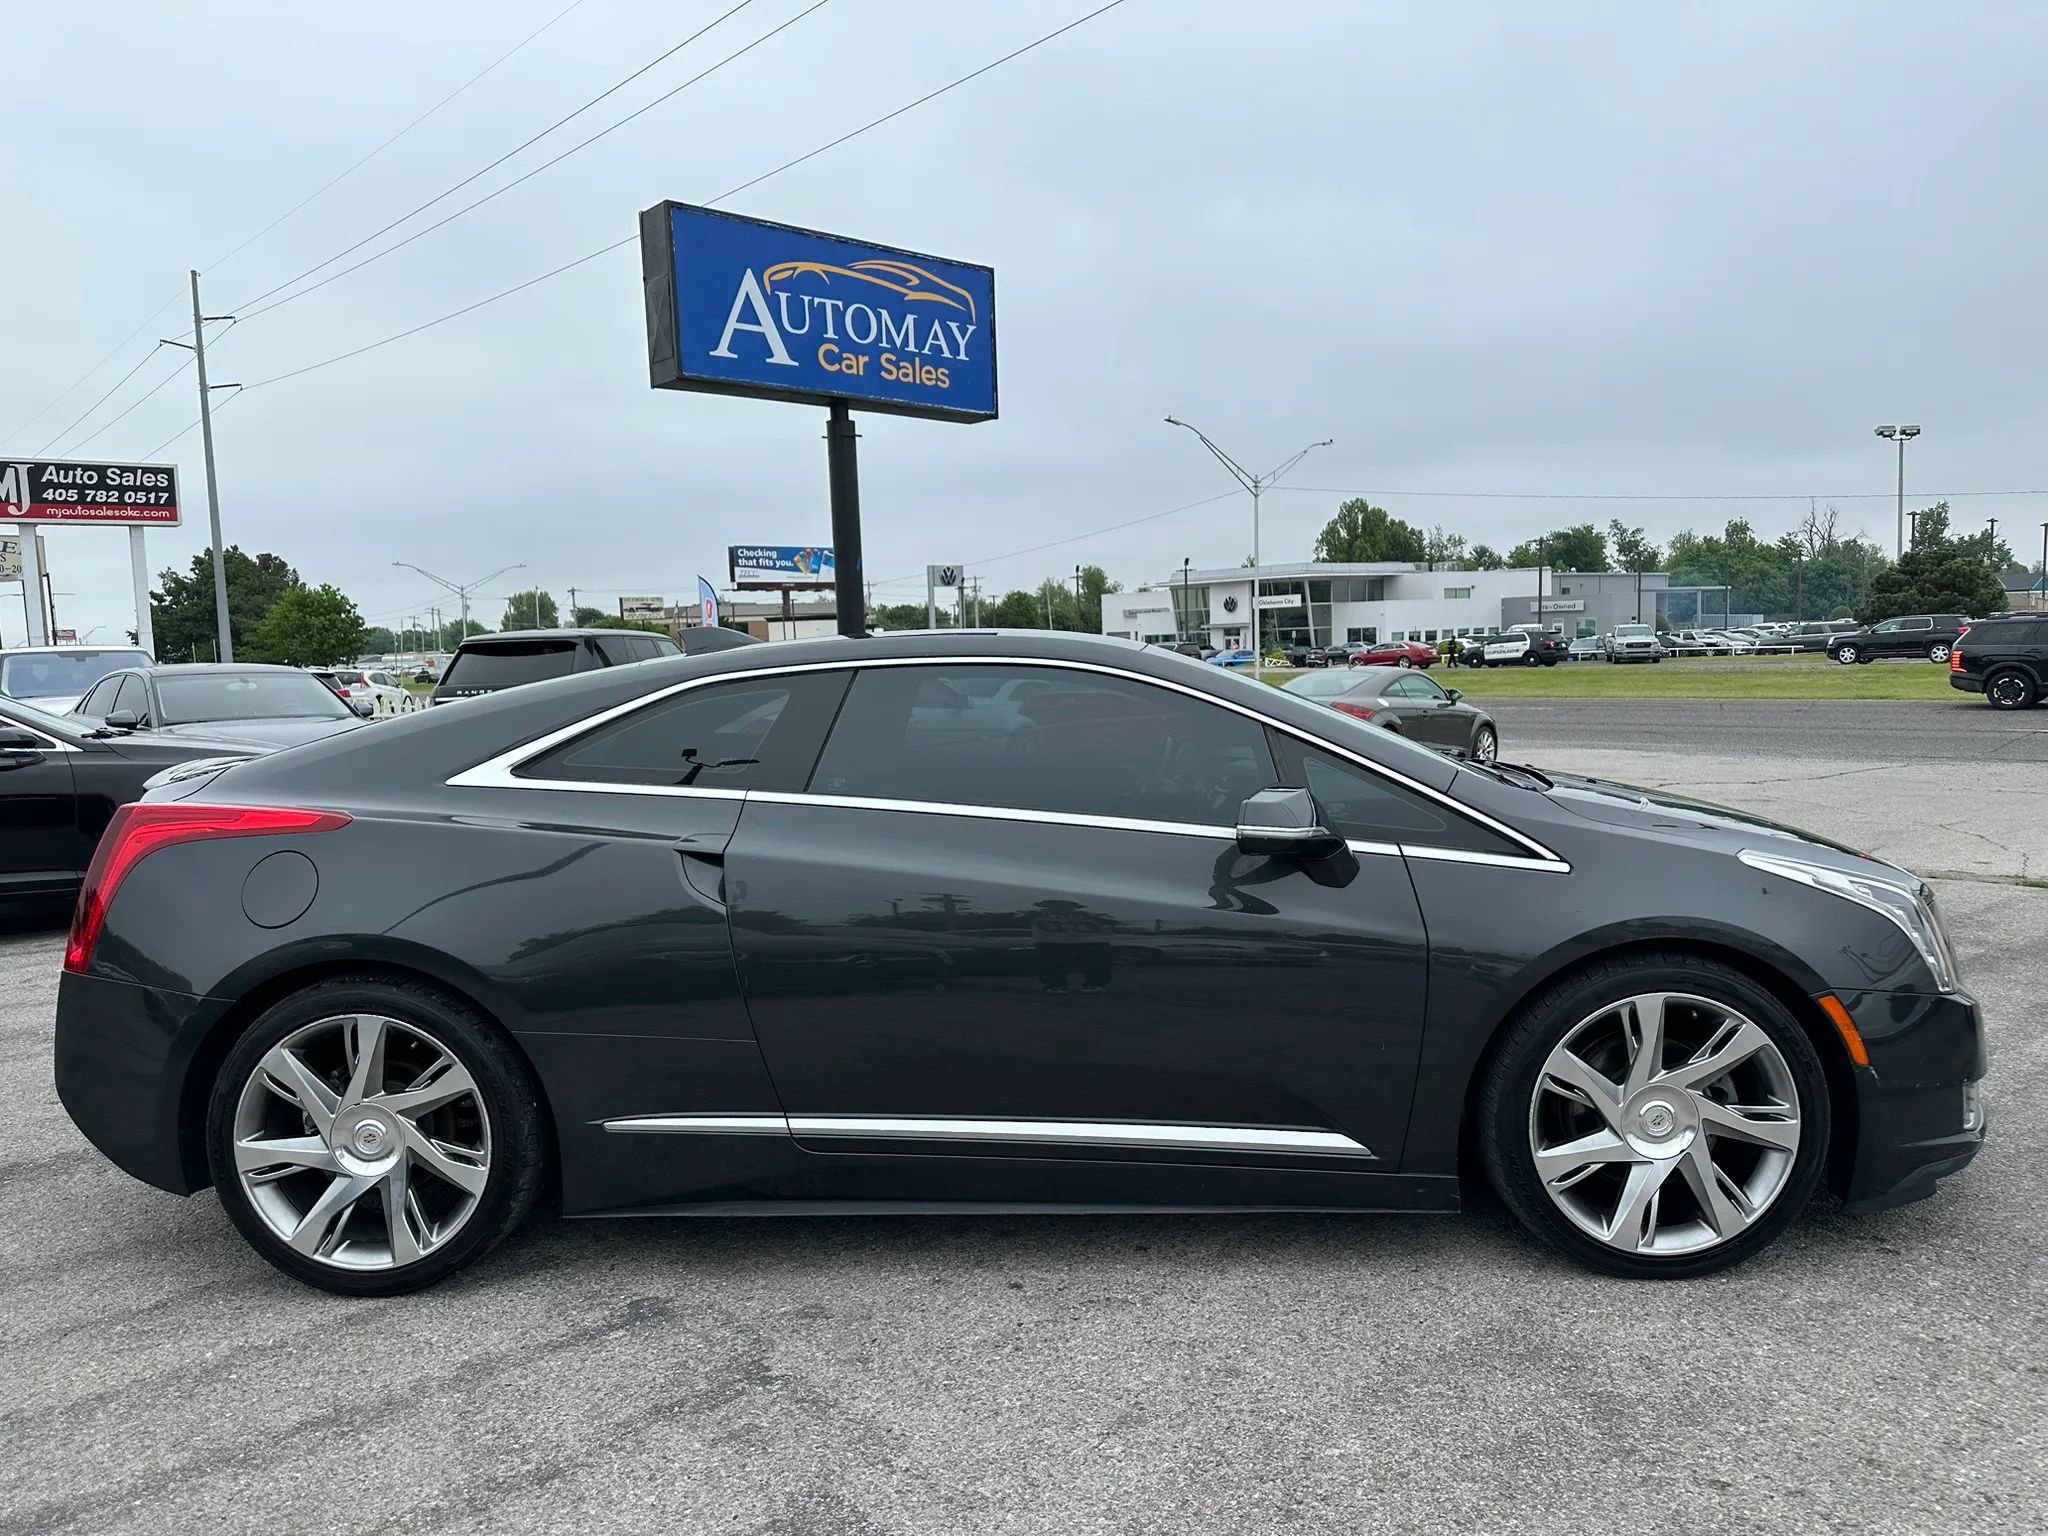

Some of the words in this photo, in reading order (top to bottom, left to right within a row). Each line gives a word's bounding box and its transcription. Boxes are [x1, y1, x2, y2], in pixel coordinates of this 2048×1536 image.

[709, 267, 977, 367] AUTOMAY
[817, 342, 870, 377] Car
[880, 352, 951, 389] Sales
[41, 465, 99, 485] Auto
[105, 467, 169, 487] Sales
[42, 488, 79, 502] 405
[84, 490, 120, 504] 782
[124, 491, 170, 505] 0517
[46, 505, 170, 518] mjautosalesokc.com
[737, 548, 777, 559] Checking
[738, 557, 757, 566] that
[759, 557, 774, 566] fits
[775, 559, 794, 568] you.
[1284, 597, 1294, 605] City
